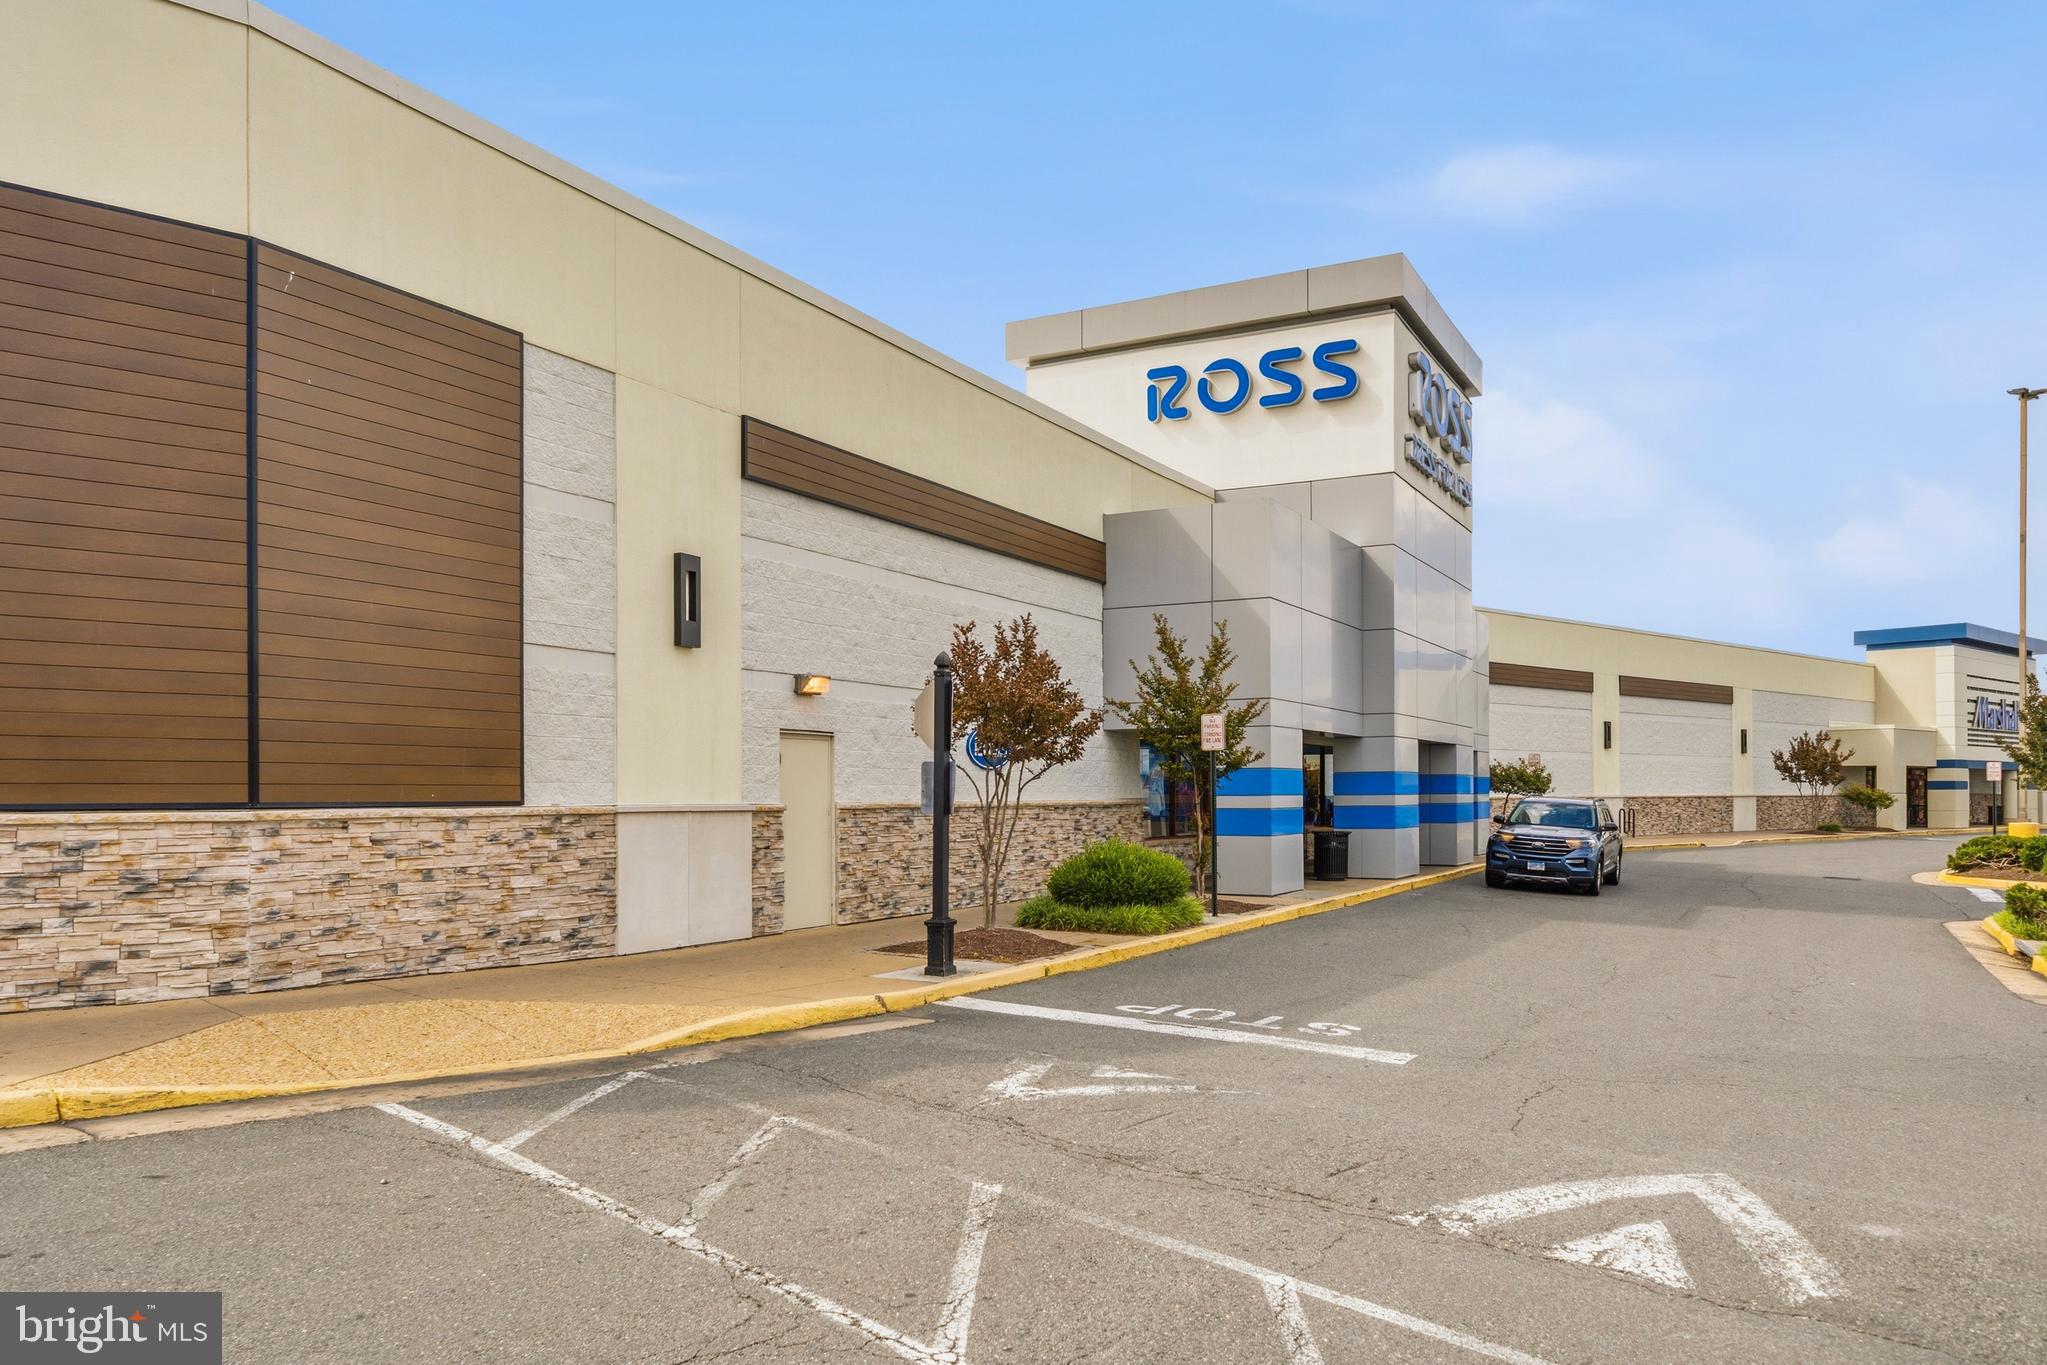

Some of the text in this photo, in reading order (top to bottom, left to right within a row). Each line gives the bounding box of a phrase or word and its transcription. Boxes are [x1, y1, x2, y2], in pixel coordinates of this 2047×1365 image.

[1147, 339, 1360, 423] ROSS
[1408, 351, 1472, 465] ROSS
[1972, 695, 2019, 731] Marshal
[1115, 1004, 1361, 1036] STOP
